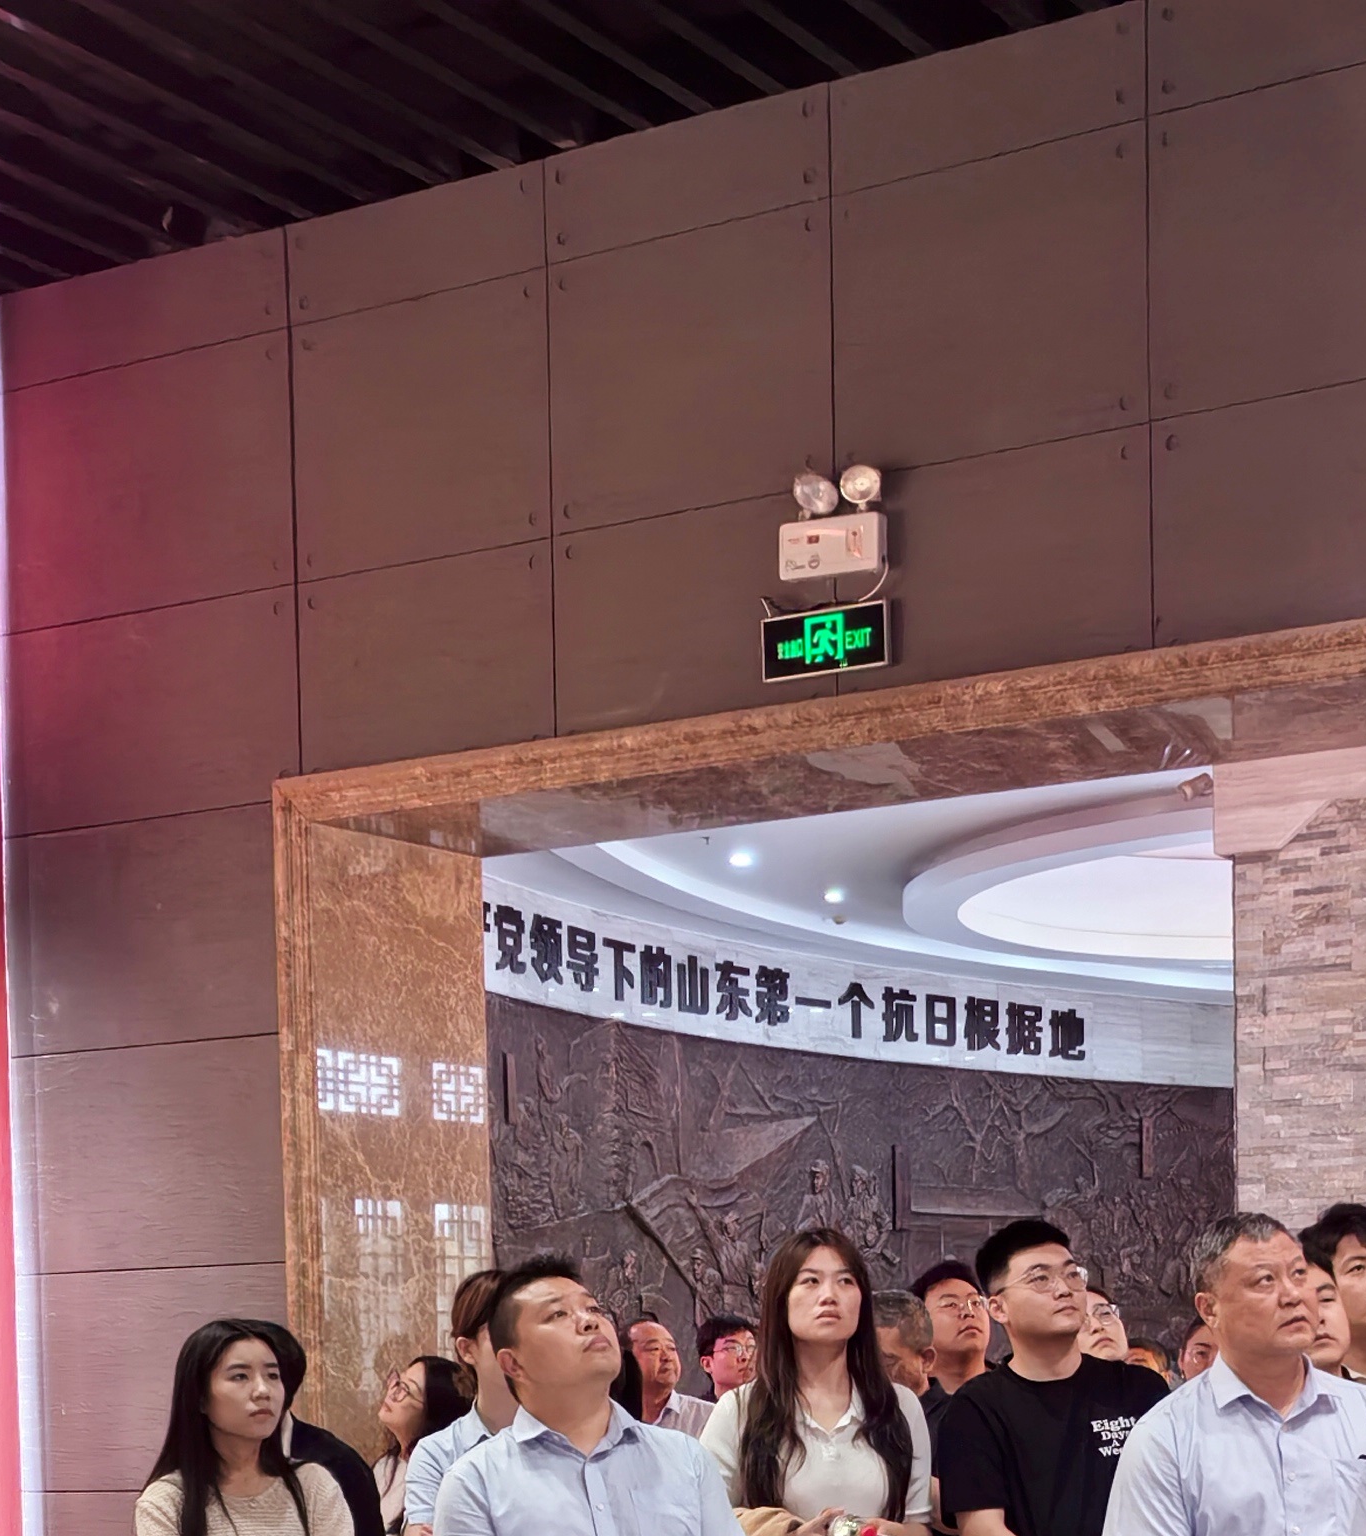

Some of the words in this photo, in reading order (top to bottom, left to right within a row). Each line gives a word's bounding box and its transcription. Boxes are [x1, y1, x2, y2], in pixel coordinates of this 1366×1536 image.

[846, 627, 872, 650] EXIT
[482, 901, 1085, 1061] 党领导下的山东第一个抗日根据地
[1091, 1416, 1136, 1432] Eight
